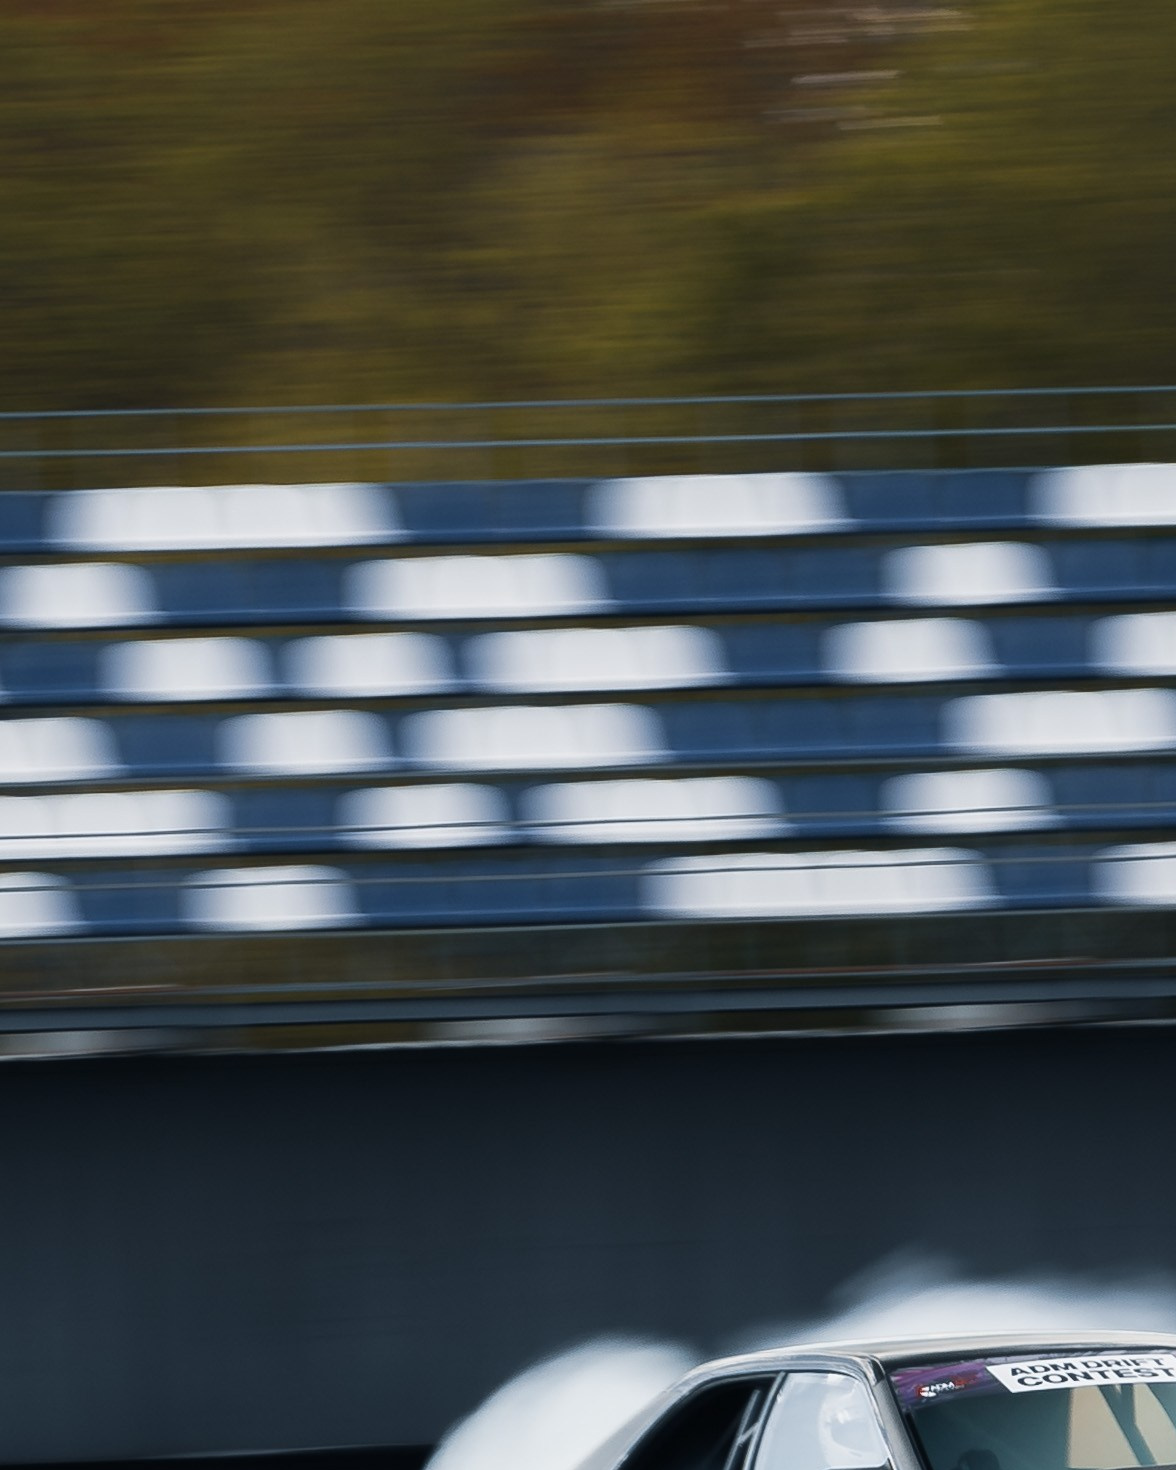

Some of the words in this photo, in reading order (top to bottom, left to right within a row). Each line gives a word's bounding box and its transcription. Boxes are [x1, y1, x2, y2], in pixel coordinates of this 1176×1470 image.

[1010, 1361, 1075, 1377] ADM
[1081, 1357, 1164, 1370] DRIFT
[1017, 1367, 1175, 1386] CONTEST
